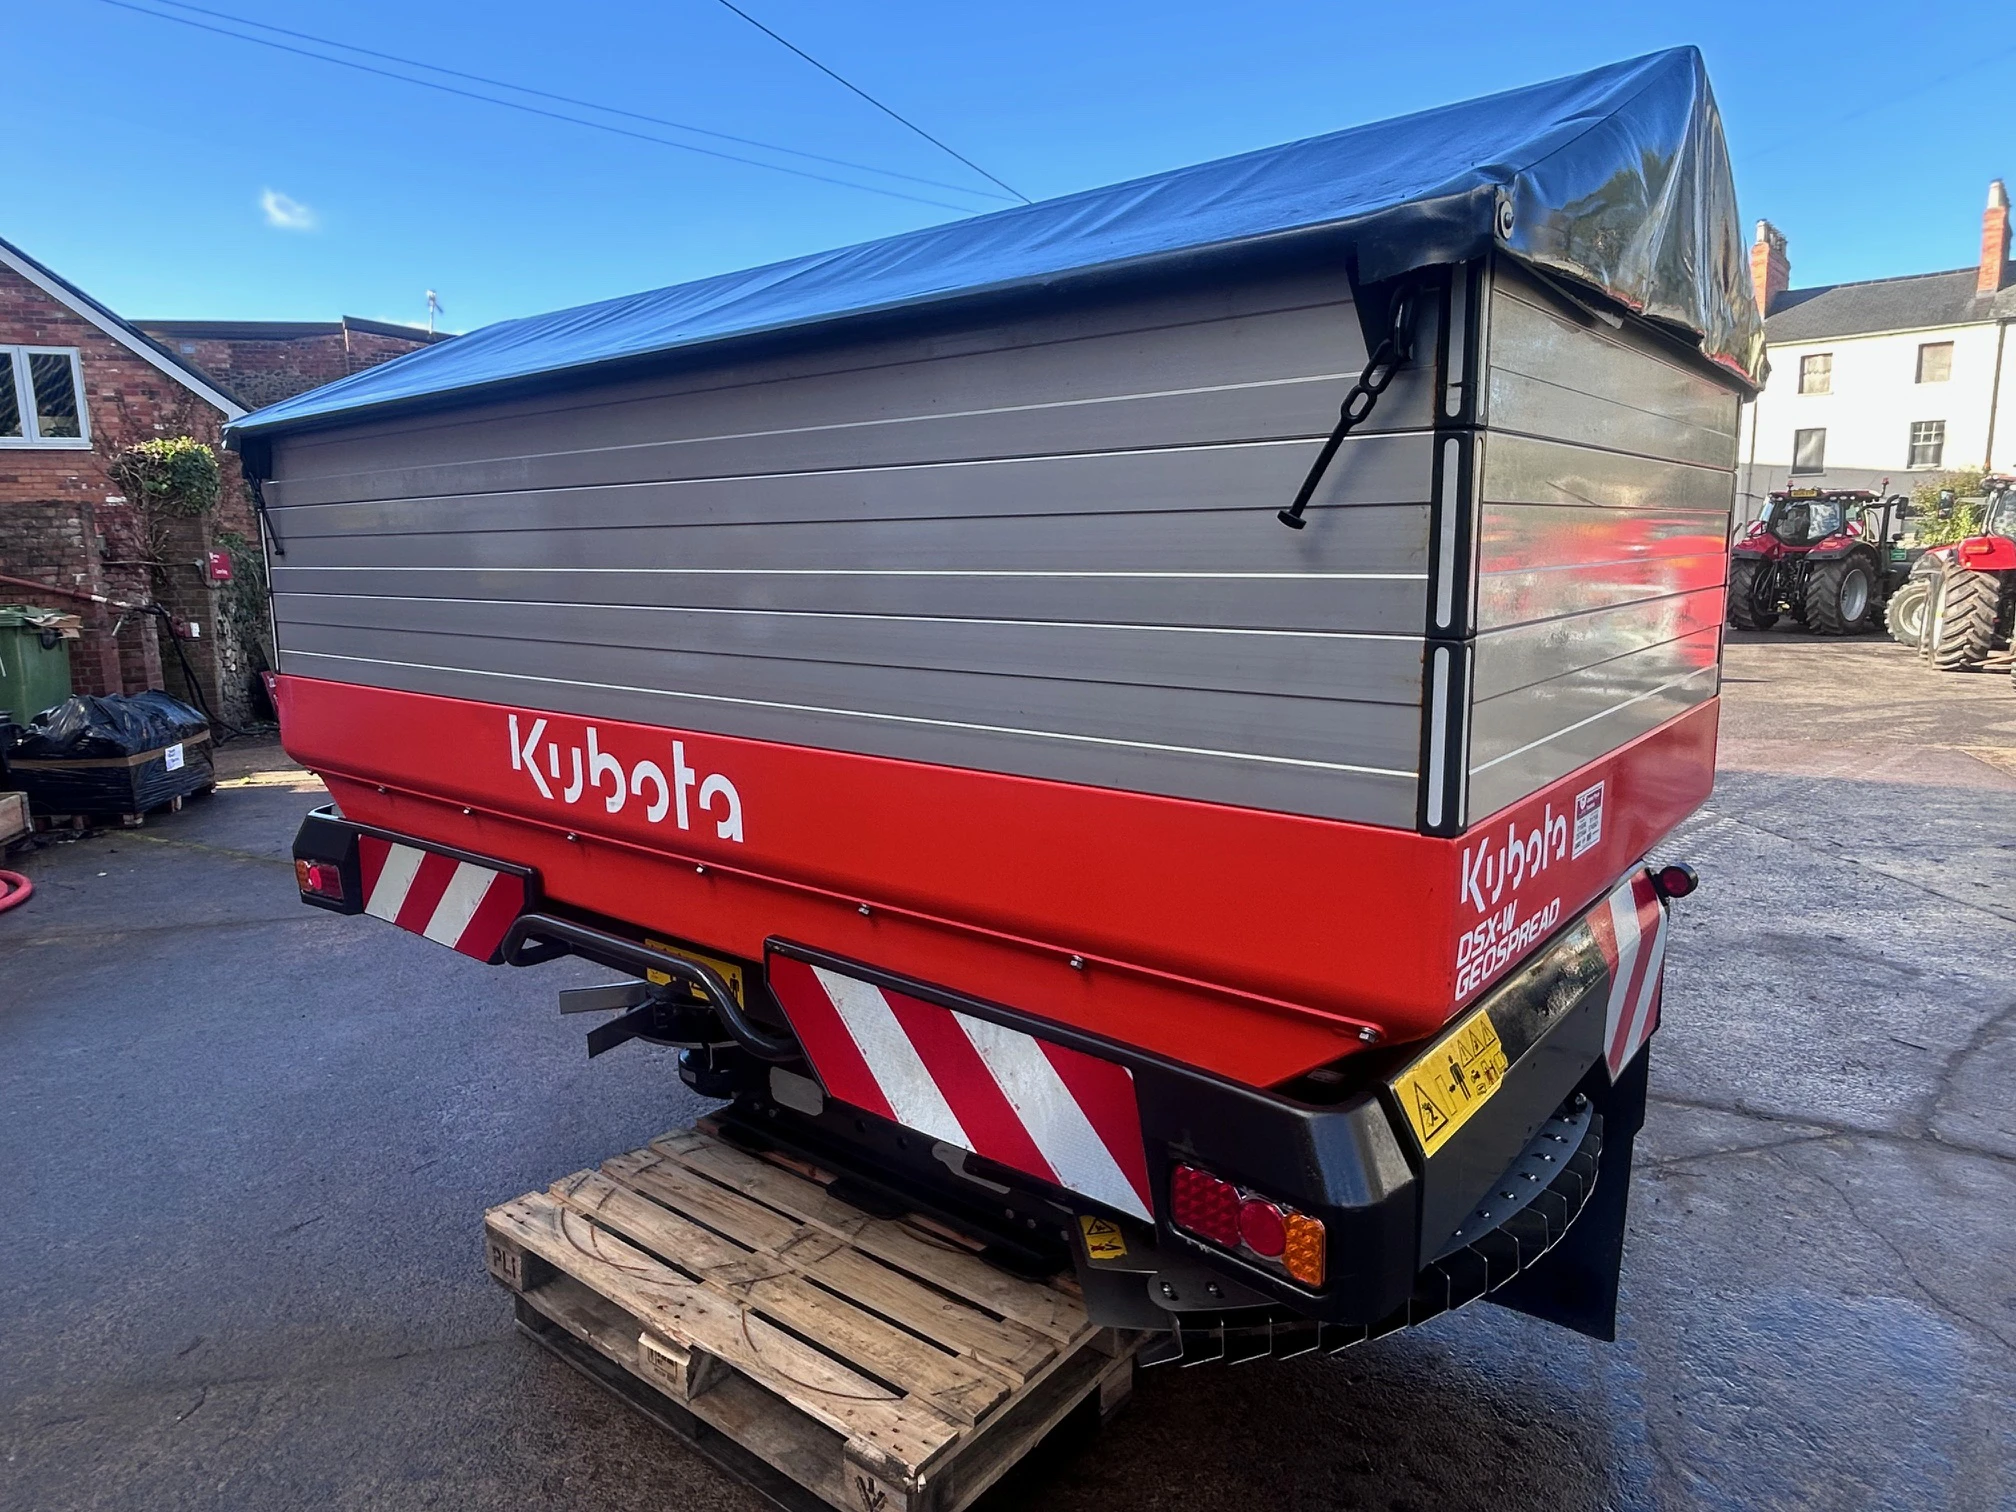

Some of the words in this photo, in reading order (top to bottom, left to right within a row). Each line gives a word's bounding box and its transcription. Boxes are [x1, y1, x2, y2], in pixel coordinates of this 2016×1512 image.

[508, 714, 744, 843] Kubota
[1460, 803, 1567, 913] Kubota
[1455, 897, 1560, 1001] GEOSPREAD
[1457, 900, 1517, 968] DSX-W
